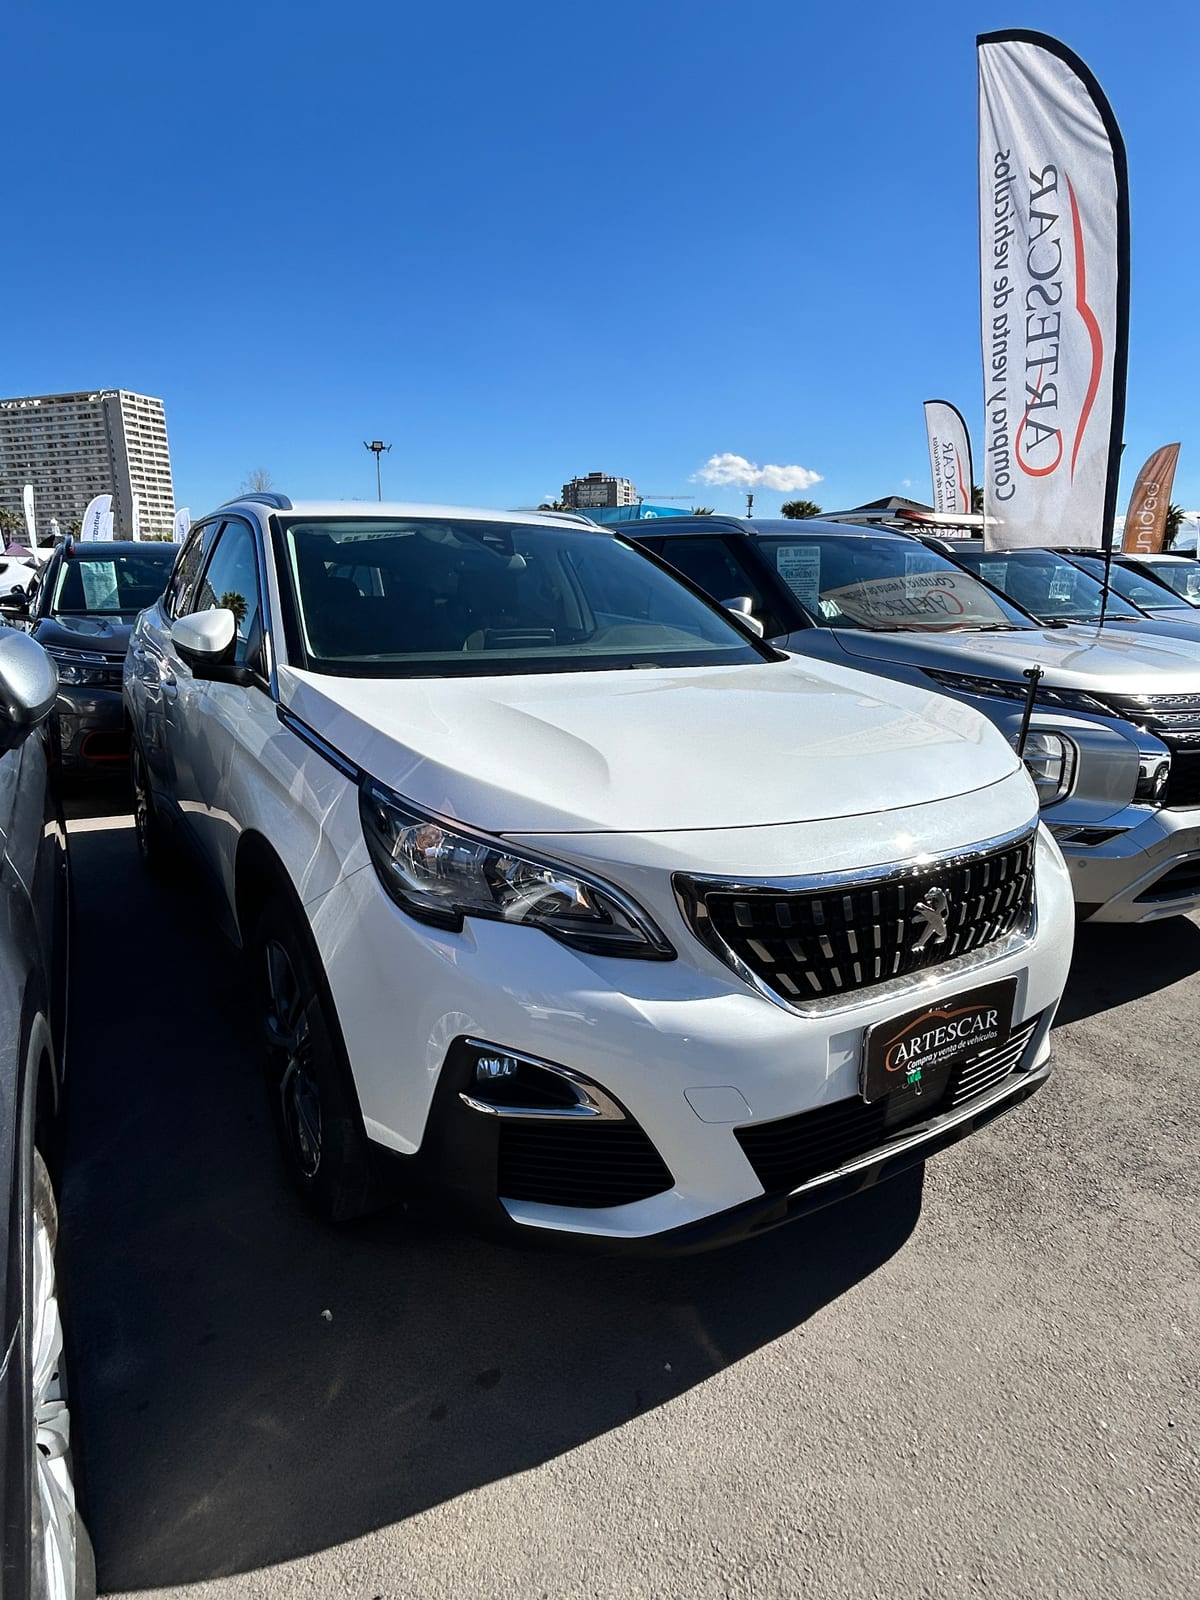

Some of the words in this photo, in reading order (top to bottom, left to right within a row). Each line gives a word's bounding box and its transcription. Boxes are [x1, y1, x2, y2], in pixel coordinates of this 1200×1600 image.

[907, 1053, 932, 1070] Compra
[938, 1044, 957, 1056] venta
[957, 1039, 967, 1049] de
